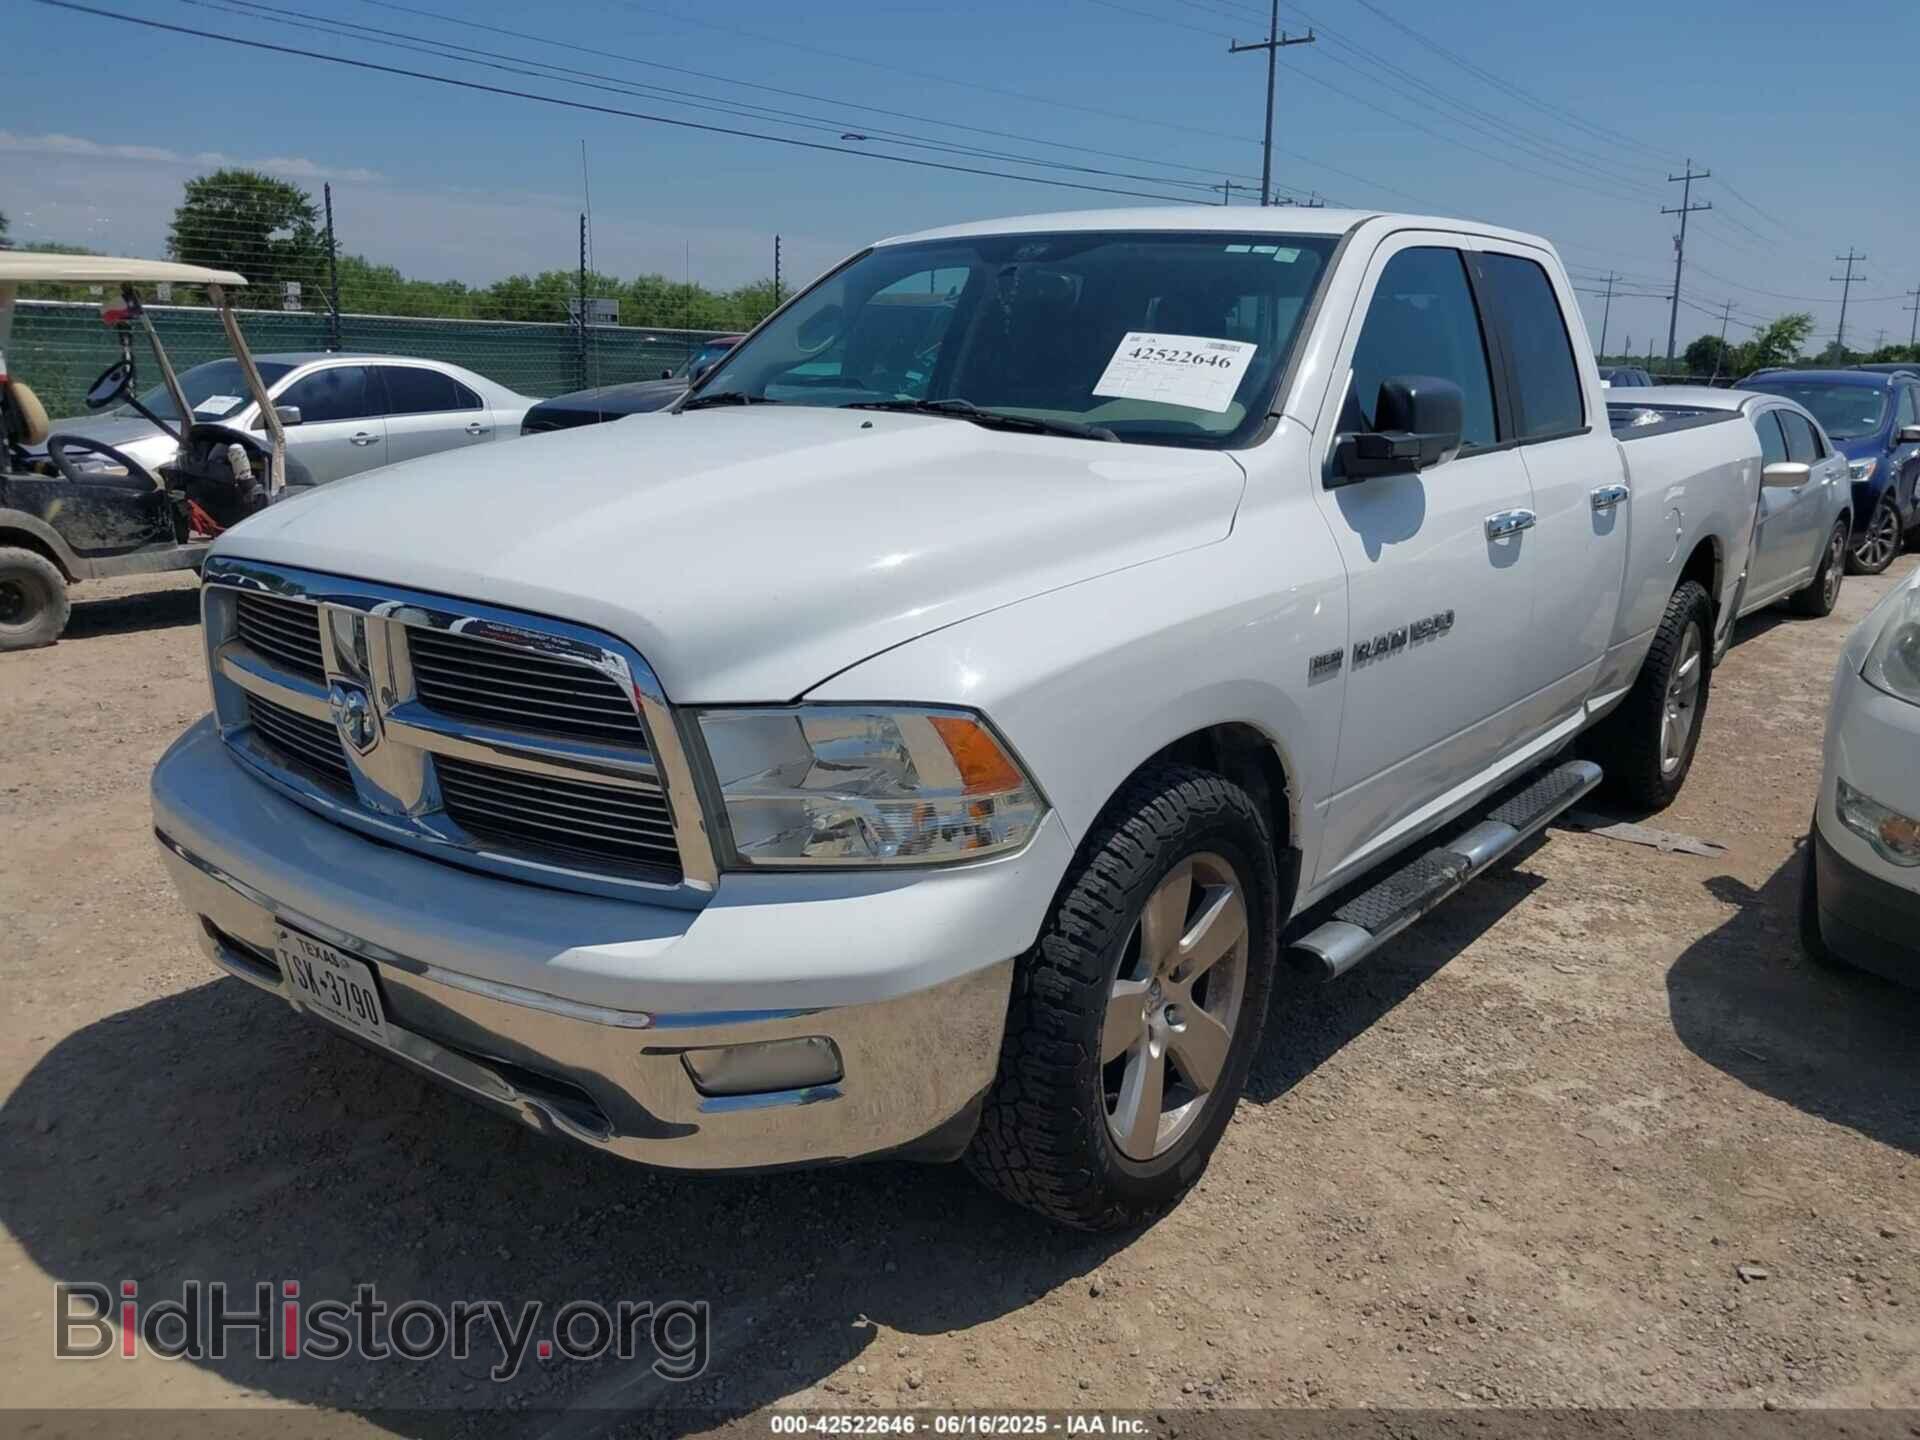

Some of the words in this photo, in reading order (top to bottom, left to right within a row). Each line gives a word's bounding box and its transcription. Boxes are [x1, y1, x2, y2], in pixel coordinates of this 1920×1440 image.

[1128, 347, 1232, 369] 42522646
[1351, 626, 1408, 666] RAM
[296, 937, 340, 968] TEXAS
